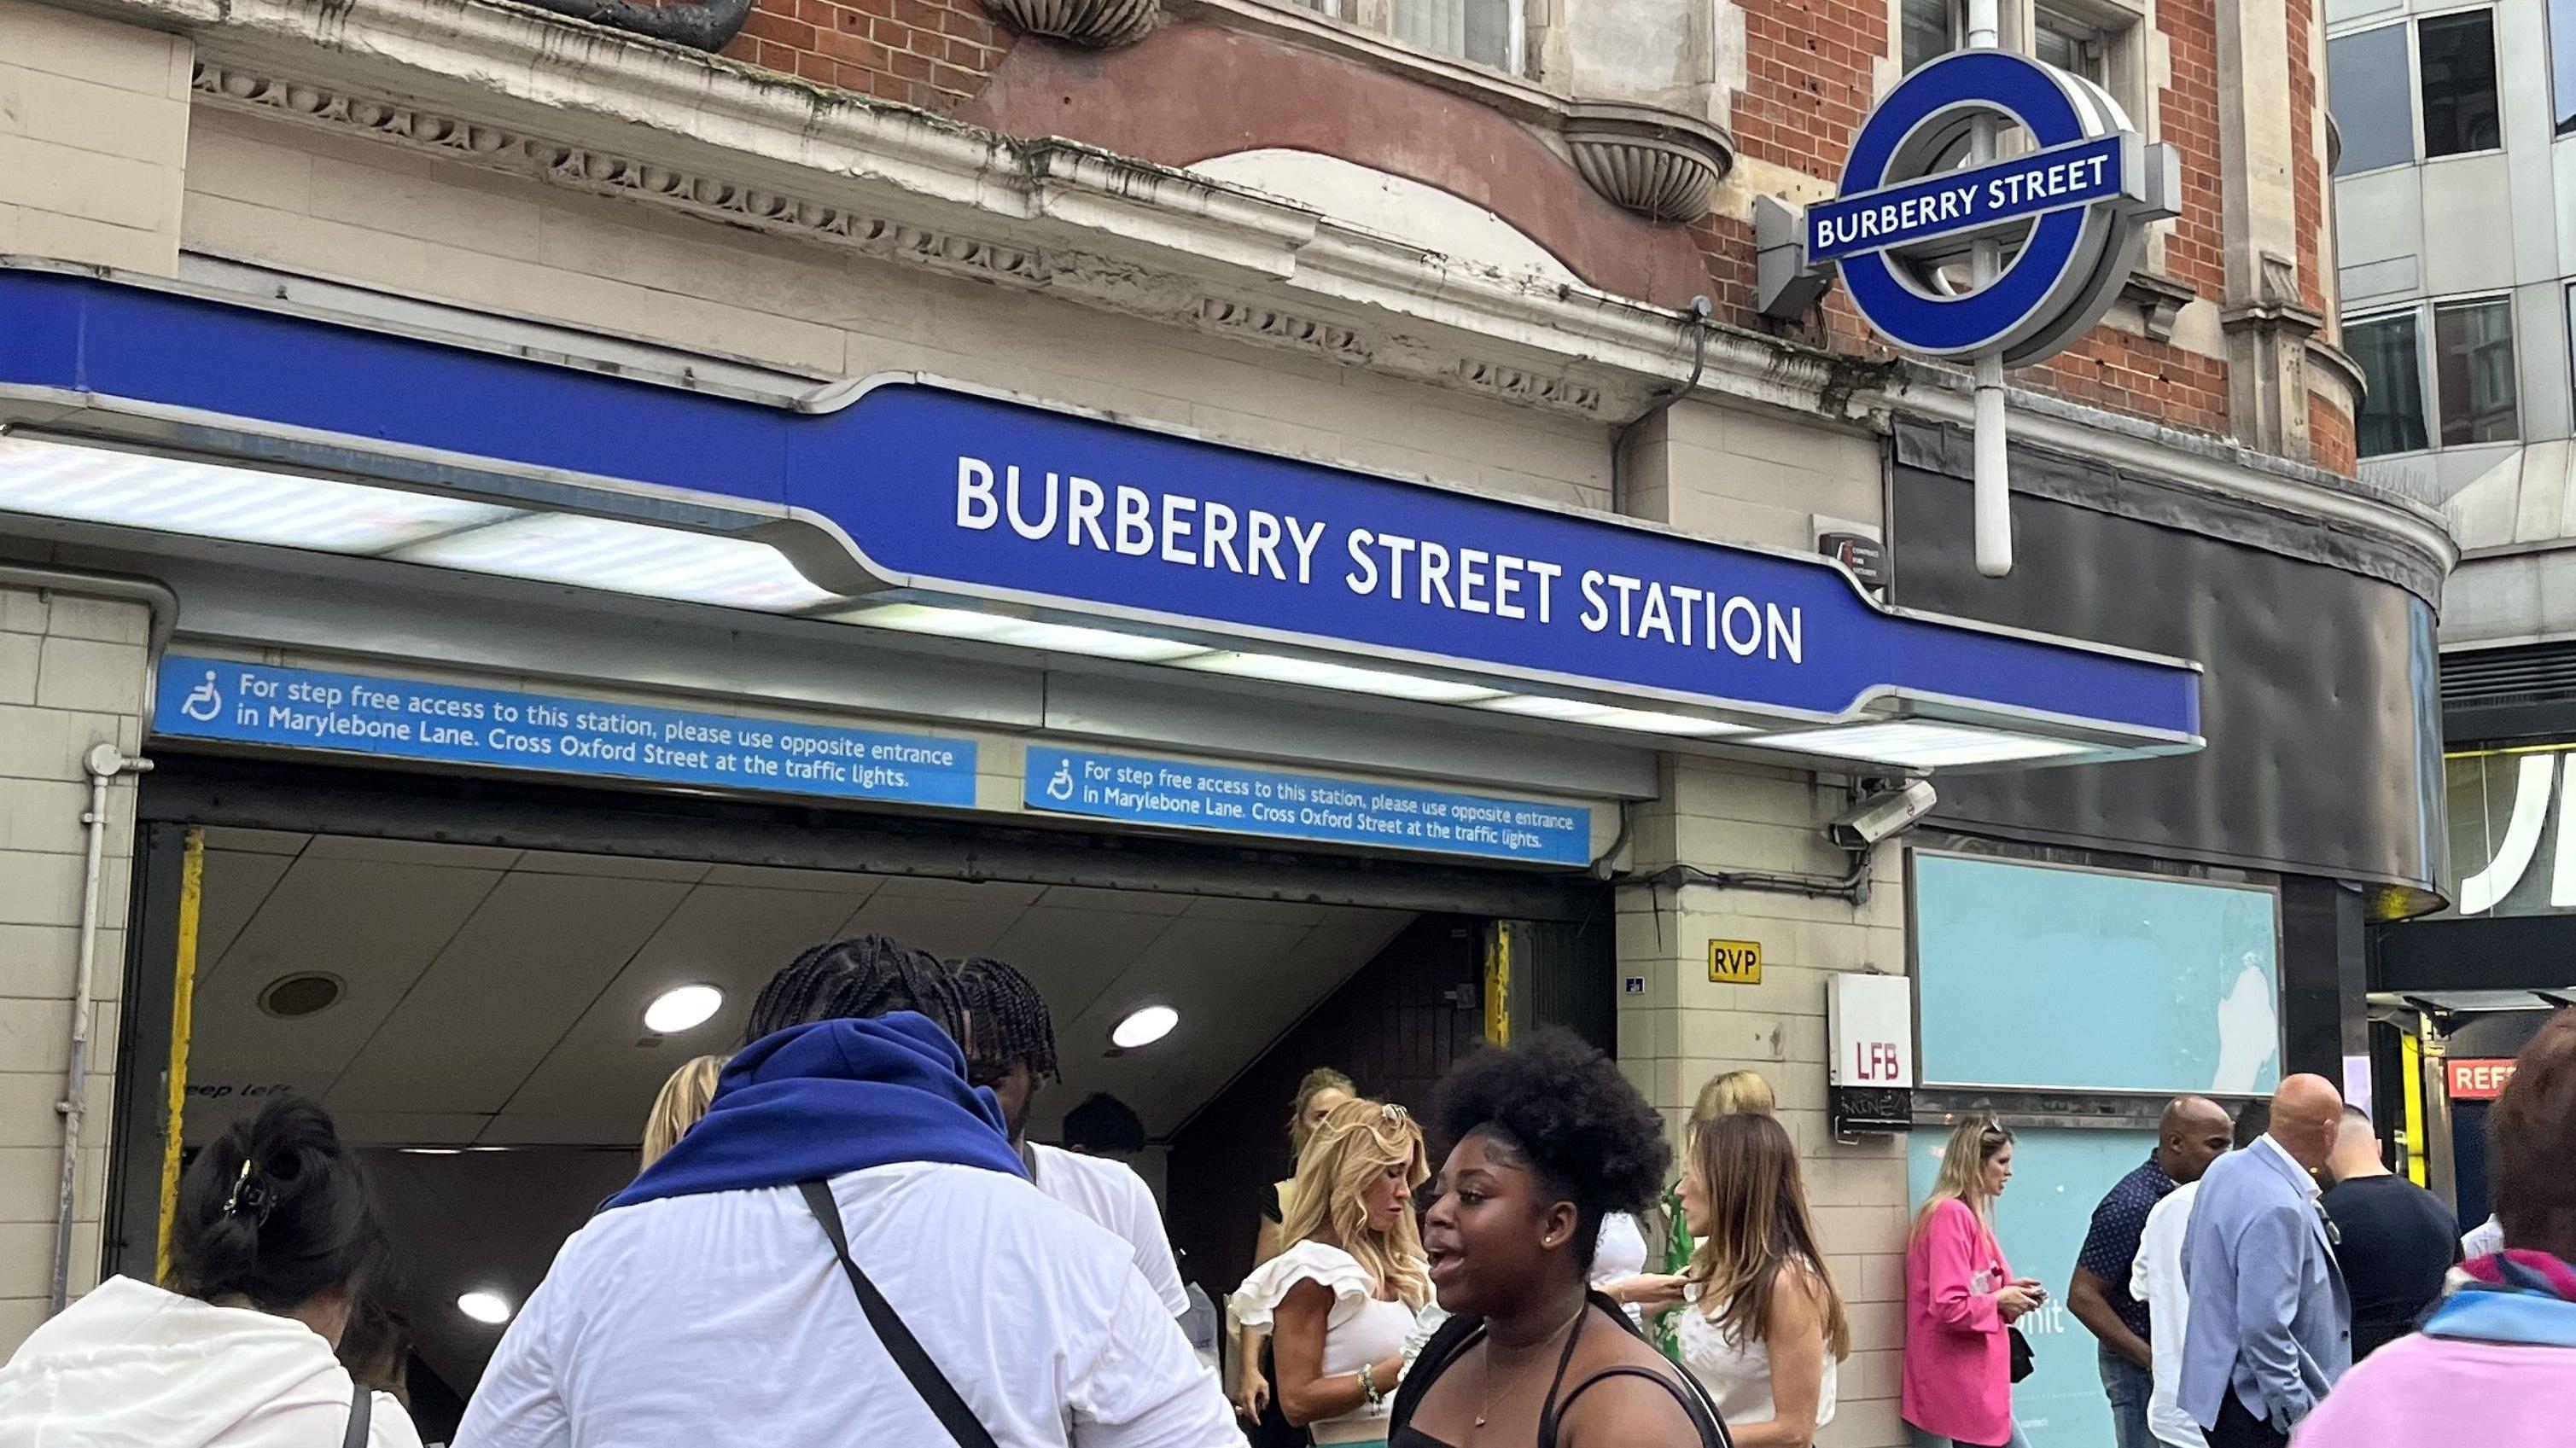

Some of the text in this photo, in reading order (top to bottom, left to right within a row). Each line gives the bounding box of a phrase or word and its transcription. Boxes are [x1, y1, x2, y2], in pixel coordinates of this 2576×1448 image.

[1818, 154, 2108, 248] BURBERRY STREET
[957, 456, 1802, 664] BURBERRY STREET STATION
[237, 704, 909, 788] in Marylebone Lane. Cross Oxford Street at the traffic lights.
[241, 673, 953, 766] For step free access to this station, please use opposite entrance
[1083, 785, 1542, 851] in Marylebone Lane. Cross Oxford Street at the traffic lights.
[1085, 760, 1573, 830] For step free access to this station, please use opposite entrance
[2460, 753, 2576, 916] J
[1715, 948, 1756, 975] RVP
[185, 1083, 233, 1100] eep
[1856, 1041, 1899, 1081] LFB
